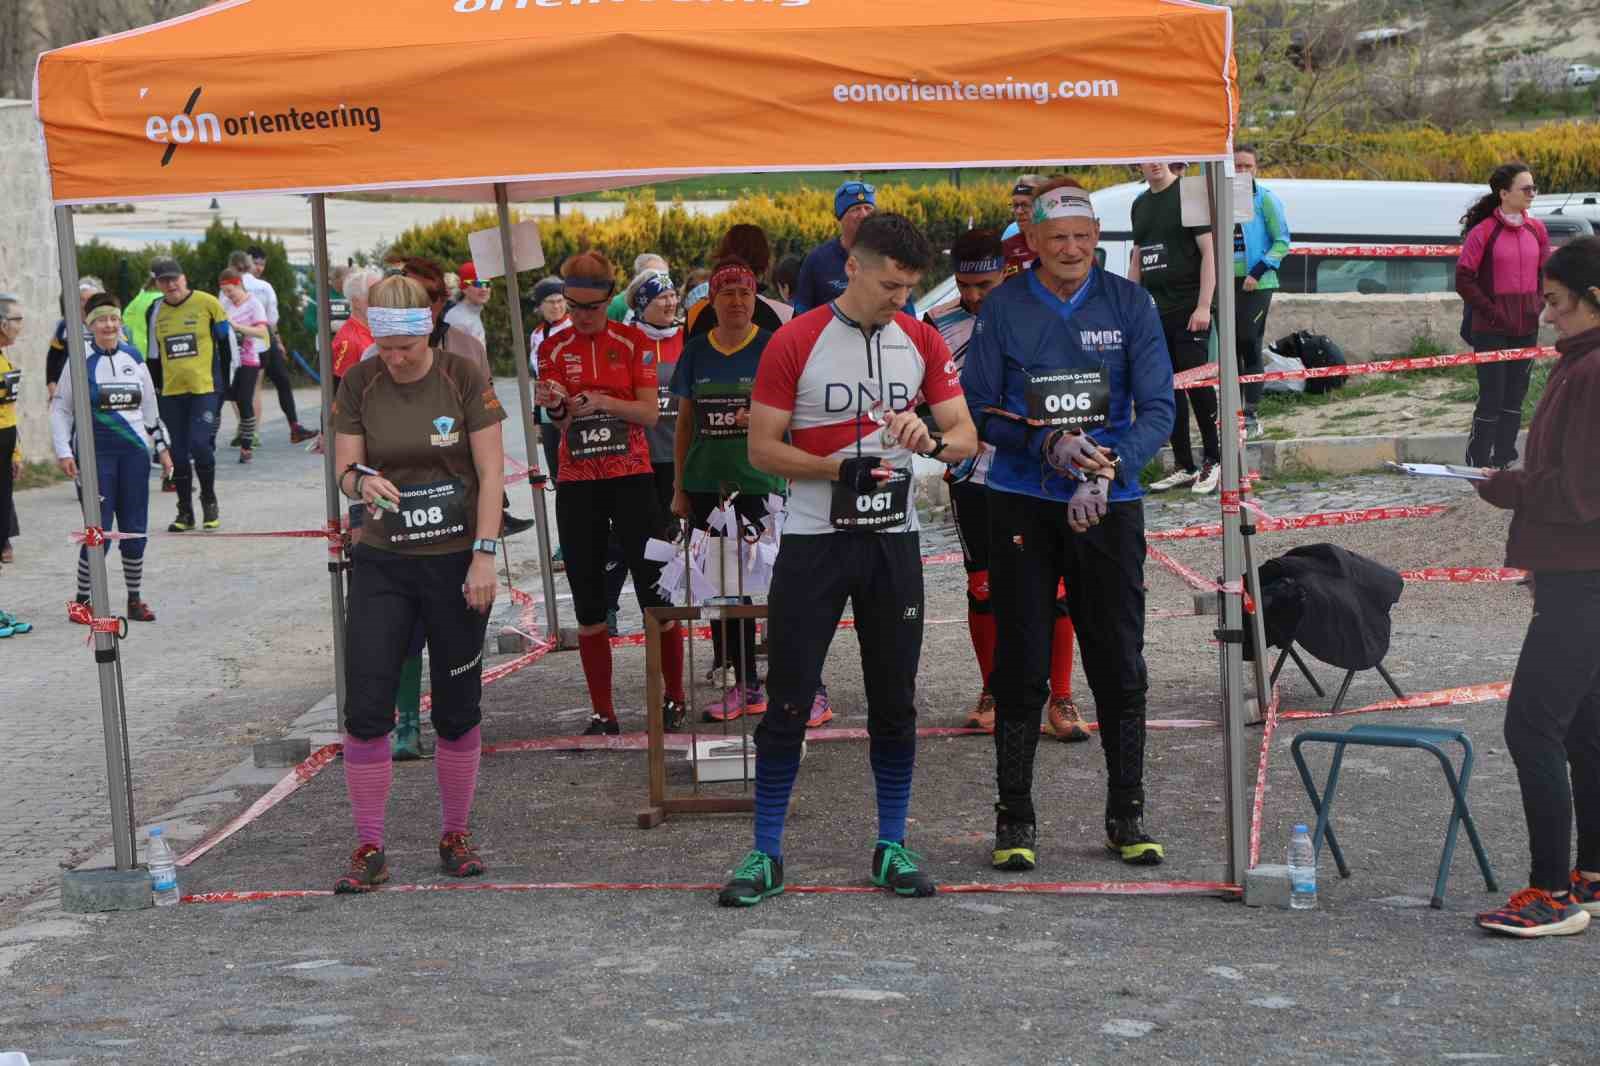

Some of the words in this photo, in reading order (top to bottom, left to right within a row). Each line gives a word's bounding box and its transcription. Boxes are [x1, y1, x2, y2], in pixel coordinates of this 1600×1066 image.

[833, 77, 1119, 105] eonorienteering.com
[223, 104, 381, 133] orienteering
[1031, 374, 1074, 383] CAPPADOCIA
[824, 381, 913, 414] DNB
[1045, 392, 1092, 413] 006
[706, 412, 737, 426] 126
[580, 427, 612, 444] 149
[855, 491, 893, 513] 061
[402, 506, 444, 528] 108
